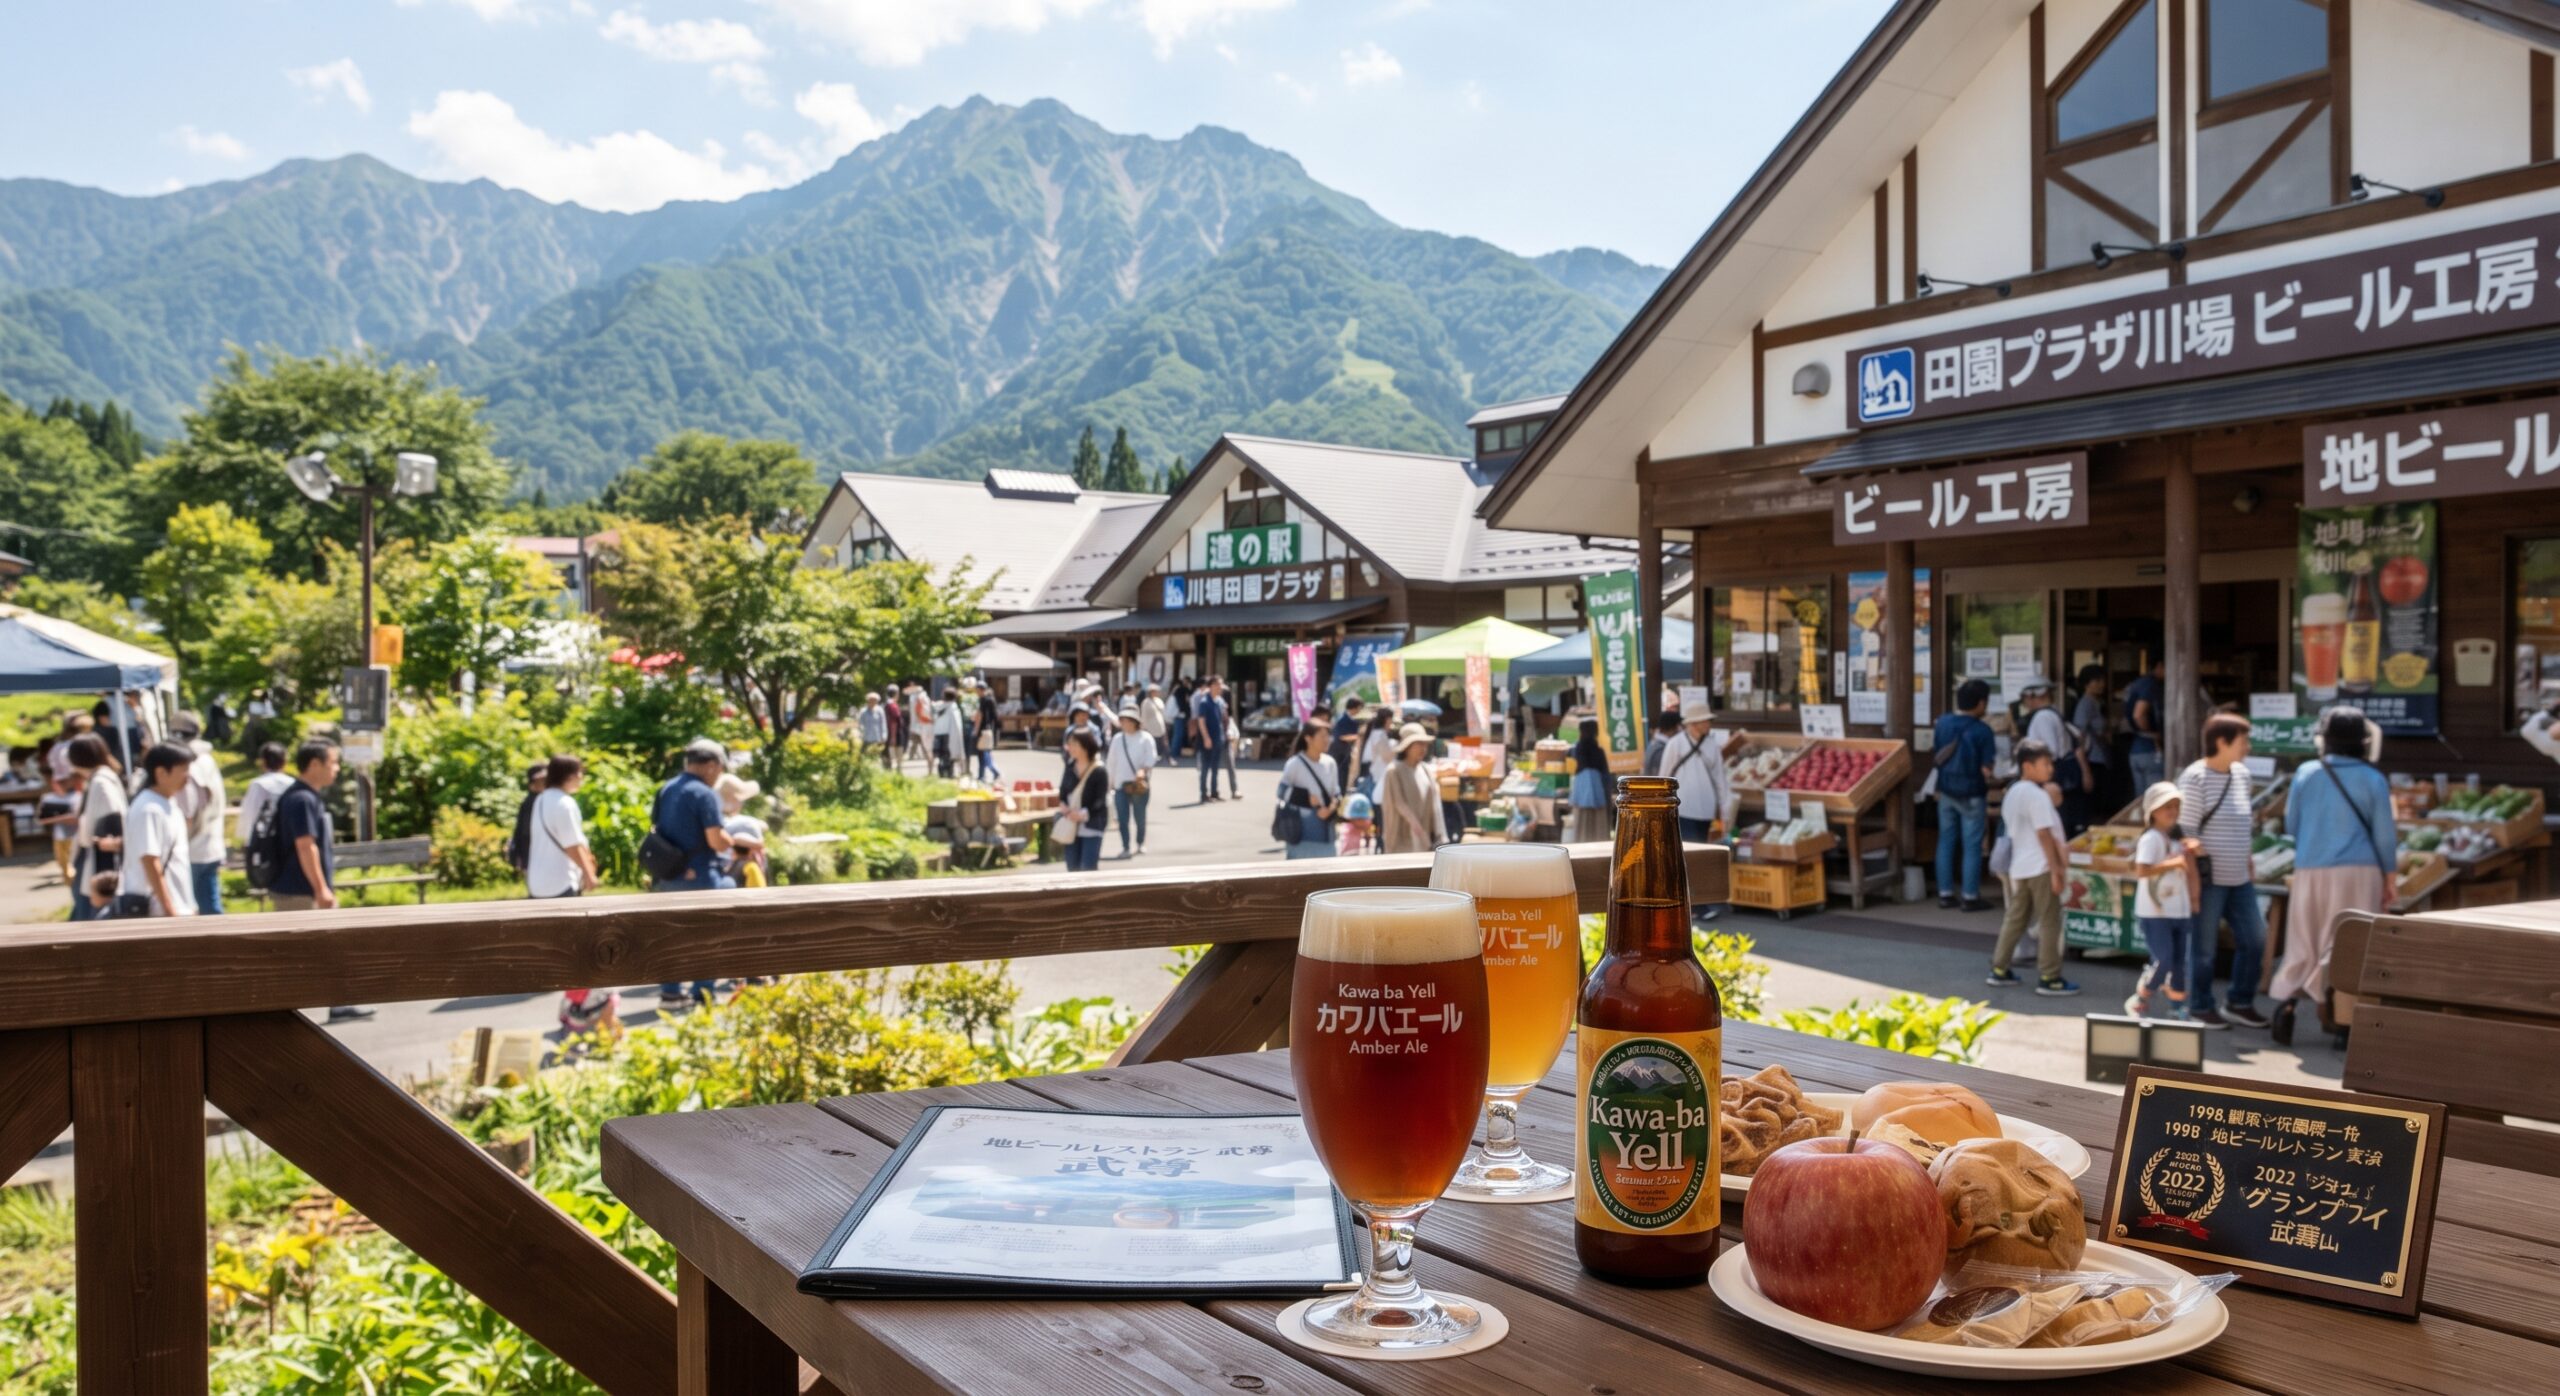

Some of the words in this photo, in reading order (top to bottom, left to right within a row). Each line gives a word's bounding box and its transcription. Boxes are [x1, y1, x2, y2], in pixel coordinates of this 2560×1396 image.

[1924, 294, 2235, 403] 田園プラザ川場
[2254, 237, 2539, 345] ビール工房
[2319, 411, 2560, 495] 地ビール
[1844, 461, 2074, 534] ビール工房
[1210, 528, 1293, 570] 道の駅
[1520, 909, 1542, 921] Yell
[1519, 954, 1538, 966] Ale
[1338, 983, 1380, 999] Kawa
[1384, 984, 1404, 999] ba
[1408, 983, 1436, 999] Yell
[1316, 1002, 1463, 1037] カワバエール
[1349, 1039, 1401, 1055] Amber
[1404, 1039, 1429, 1054] Ale
[1590, 1094, 1706, 1131] Kawa-ba
[1609, 1131, 1685, 1171] Yell
[2158, 1169, 2206, 1192] 2022
[2254, 1165, 2296, 1186] 2022
